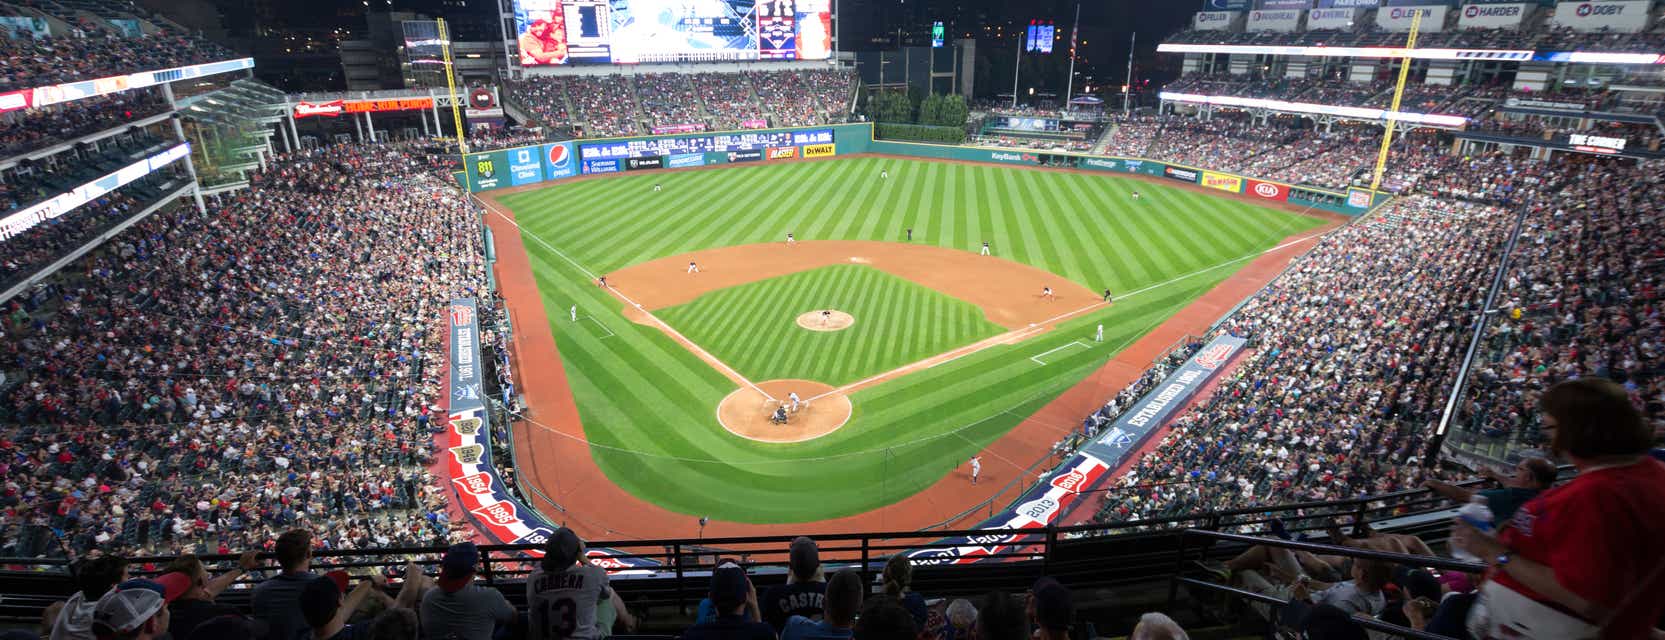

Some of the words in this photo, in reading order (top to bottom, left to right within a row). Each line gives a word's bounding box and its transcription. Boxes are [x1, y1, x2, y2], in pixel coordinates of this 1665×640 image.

[1401, 8, 1431, 17] LEON
[1479, 6, 1519, 16] HARDER
[1592, 5, 1625, 15] DOBY
[1569, 133, 1588, 146] THE
[991, 152, 1022, 161] KeyBank
[478, 160, 493, 173] 811
[1258, 186, 1274, 195] KIA
[1127, 382, 1185, 427] ESTABLISHED
[1026, 499, 1054, 518] 2013
[778, 591, 825, 612] CASTR
